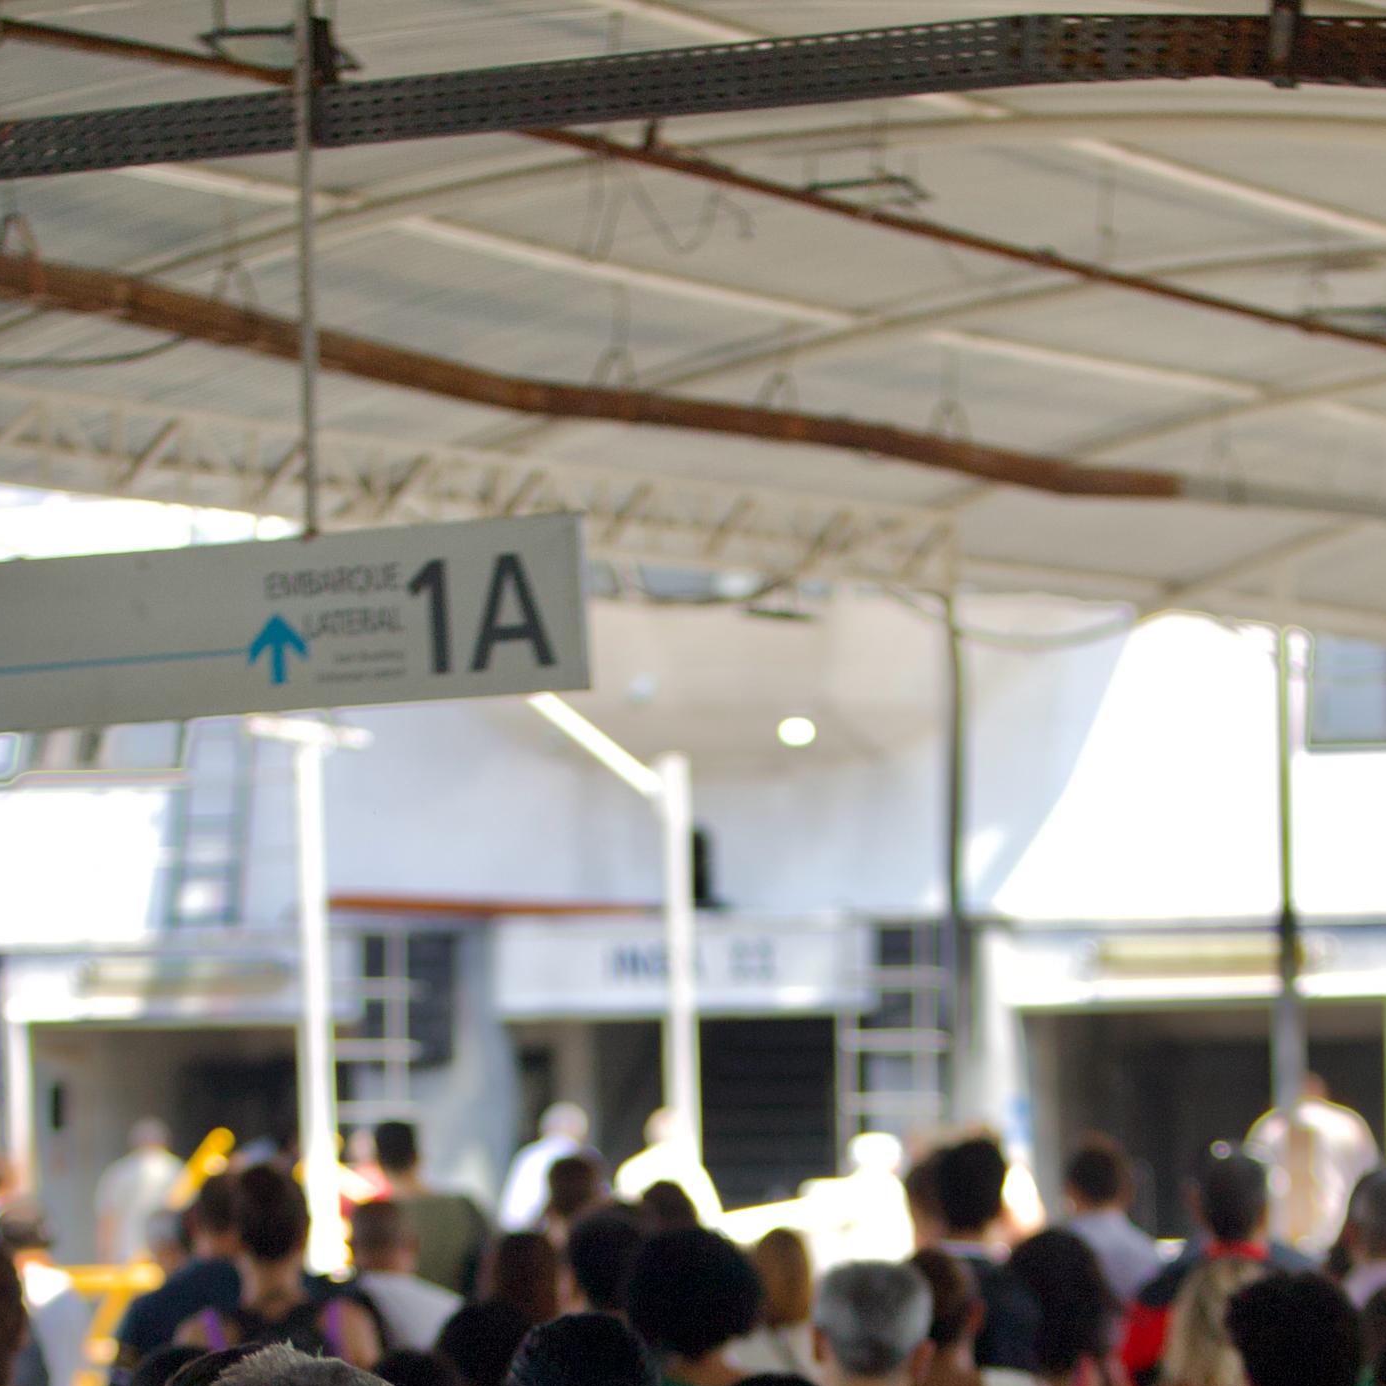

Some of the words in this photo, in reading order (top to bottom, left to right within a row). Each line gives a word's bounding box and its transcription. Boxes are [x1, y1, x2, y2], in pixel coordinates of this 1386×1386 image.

[264, 562, 401, 599] EMBARQUE
[302, 607, 404, 639] LATERAL
[405, 551, 557, 674] 1A
